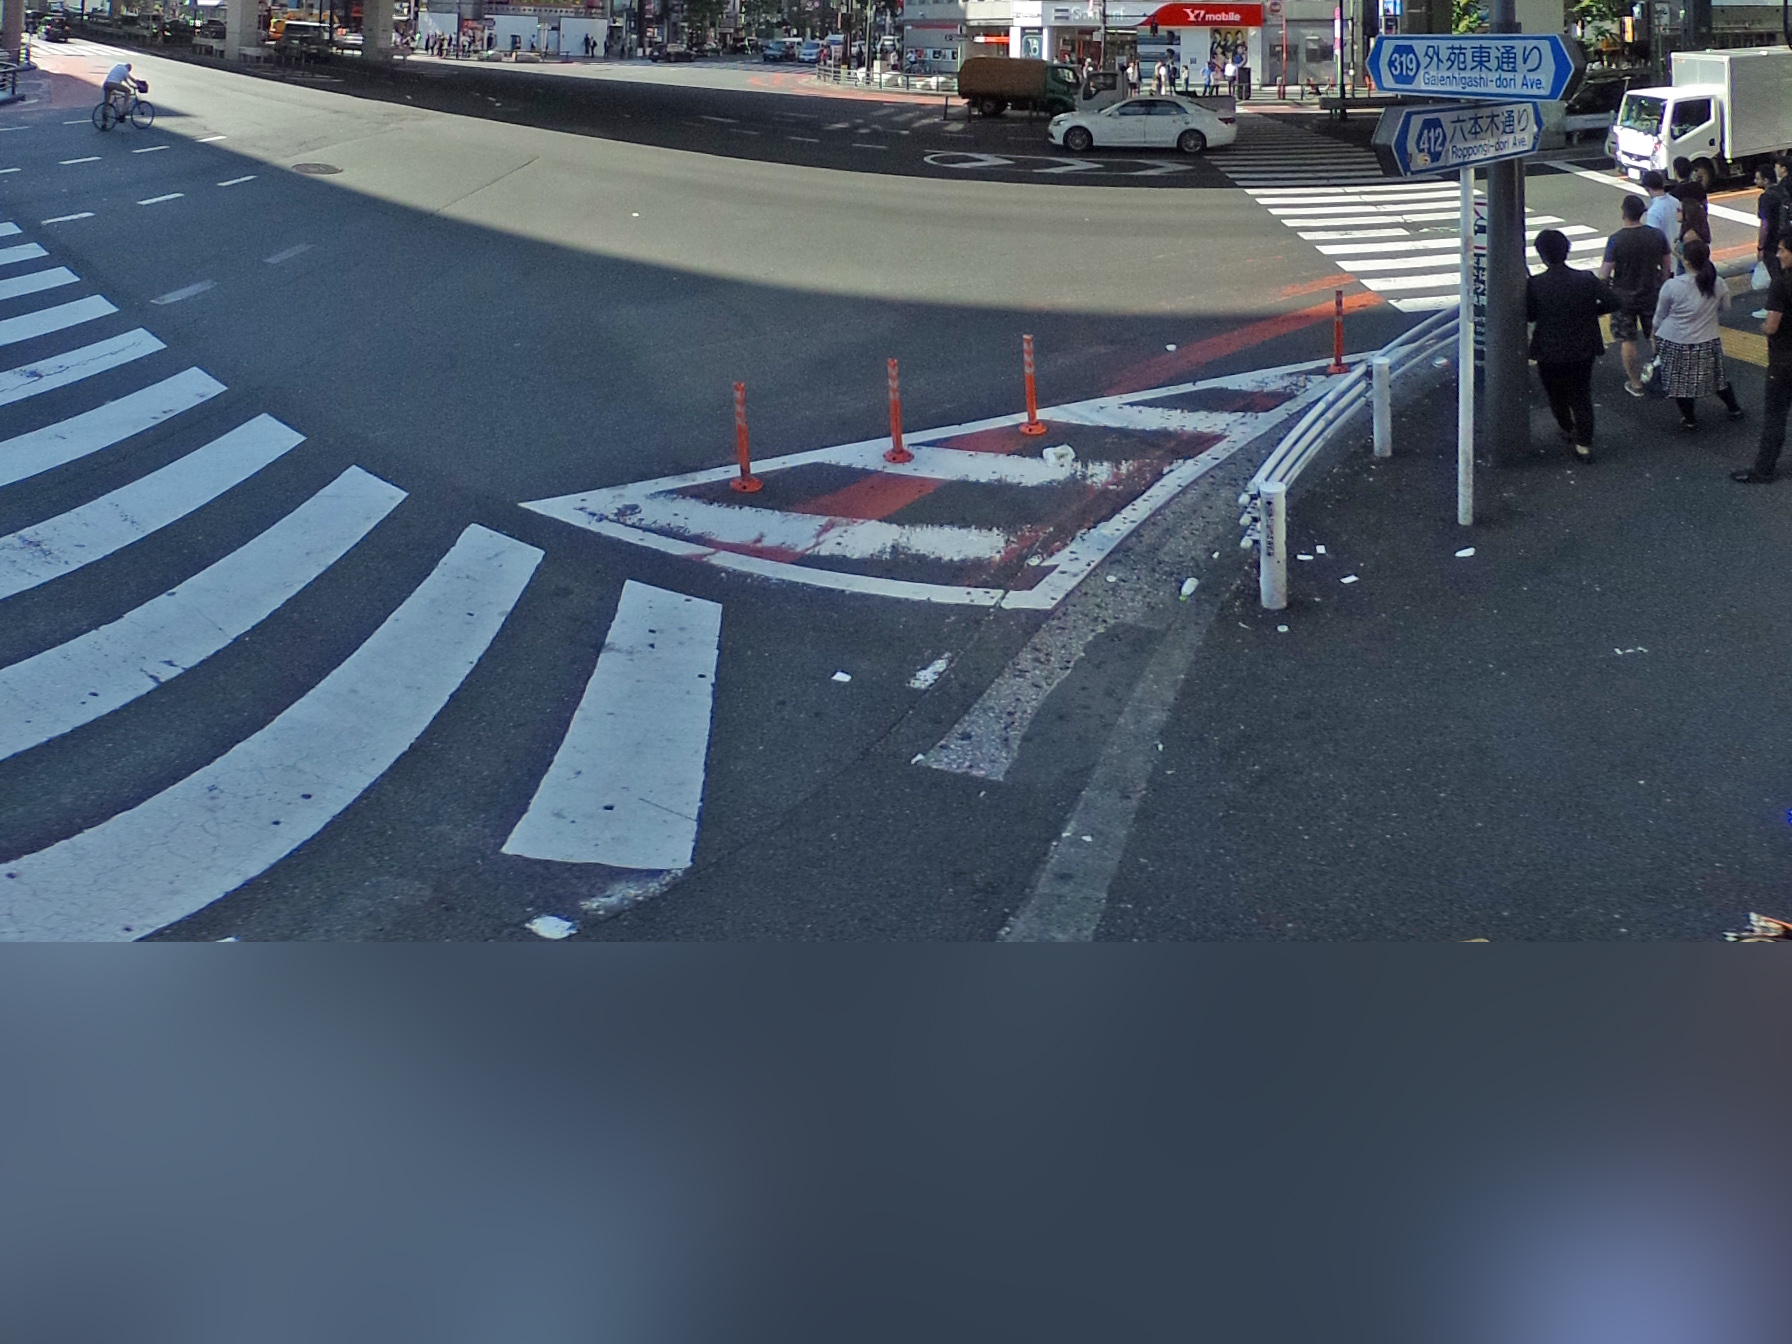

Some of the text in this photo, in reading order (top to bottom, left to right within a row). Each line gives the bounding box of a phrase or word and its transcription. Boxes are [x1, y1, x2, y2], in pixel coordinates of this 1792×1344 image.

[1390, 53, 1416, 76] 319
[1423, 44, 1543, 73] 外苑東通り
[1423, 72, 1545, 90] Gaienhigashi-dori Ave.
[1449, 108, 1529, 143] 六本木通り
[1419, 128, 1444, 154] 412
[1451, 139, 1509, 160] Roppongi-dori
